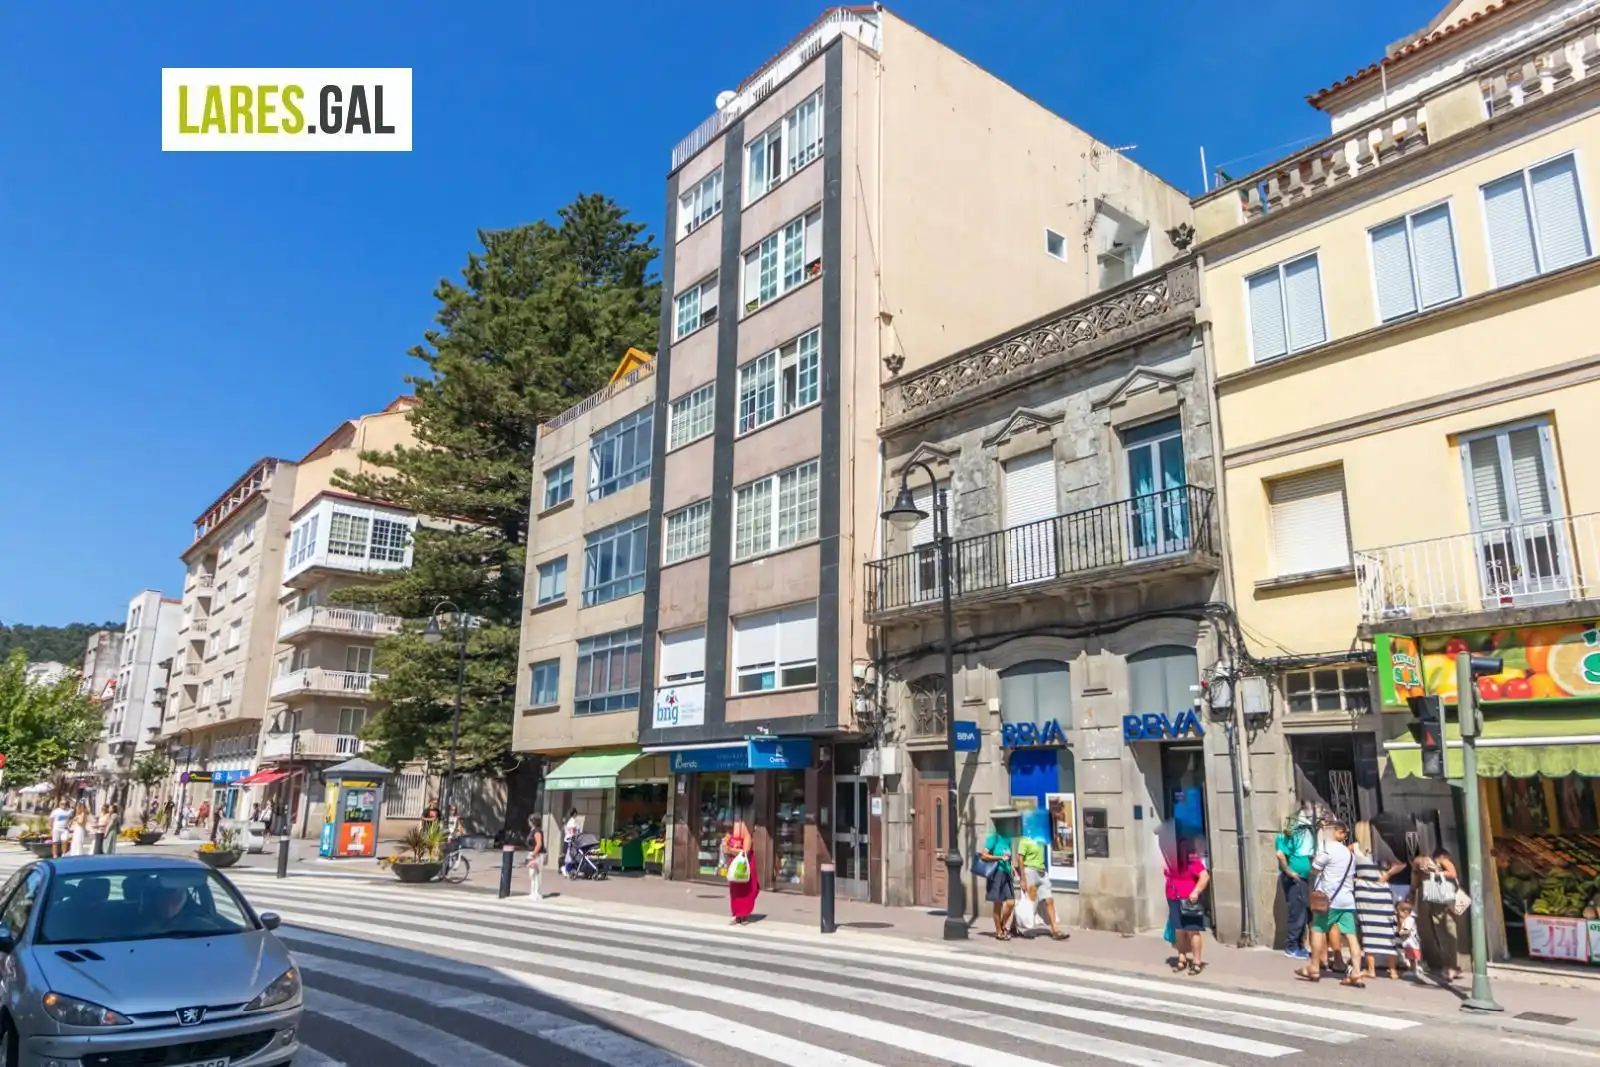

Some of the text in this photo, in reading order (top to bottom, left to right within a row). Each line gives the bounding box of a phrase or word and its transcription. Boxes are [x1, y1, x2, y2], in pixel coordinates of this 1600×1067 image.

[656, 702, 679, 725] bng
[1123, 707, 1206, 741] BBVA
[956, 732, 975, 741] BBVA
[1002, 718, 1067, 746] BBVA
